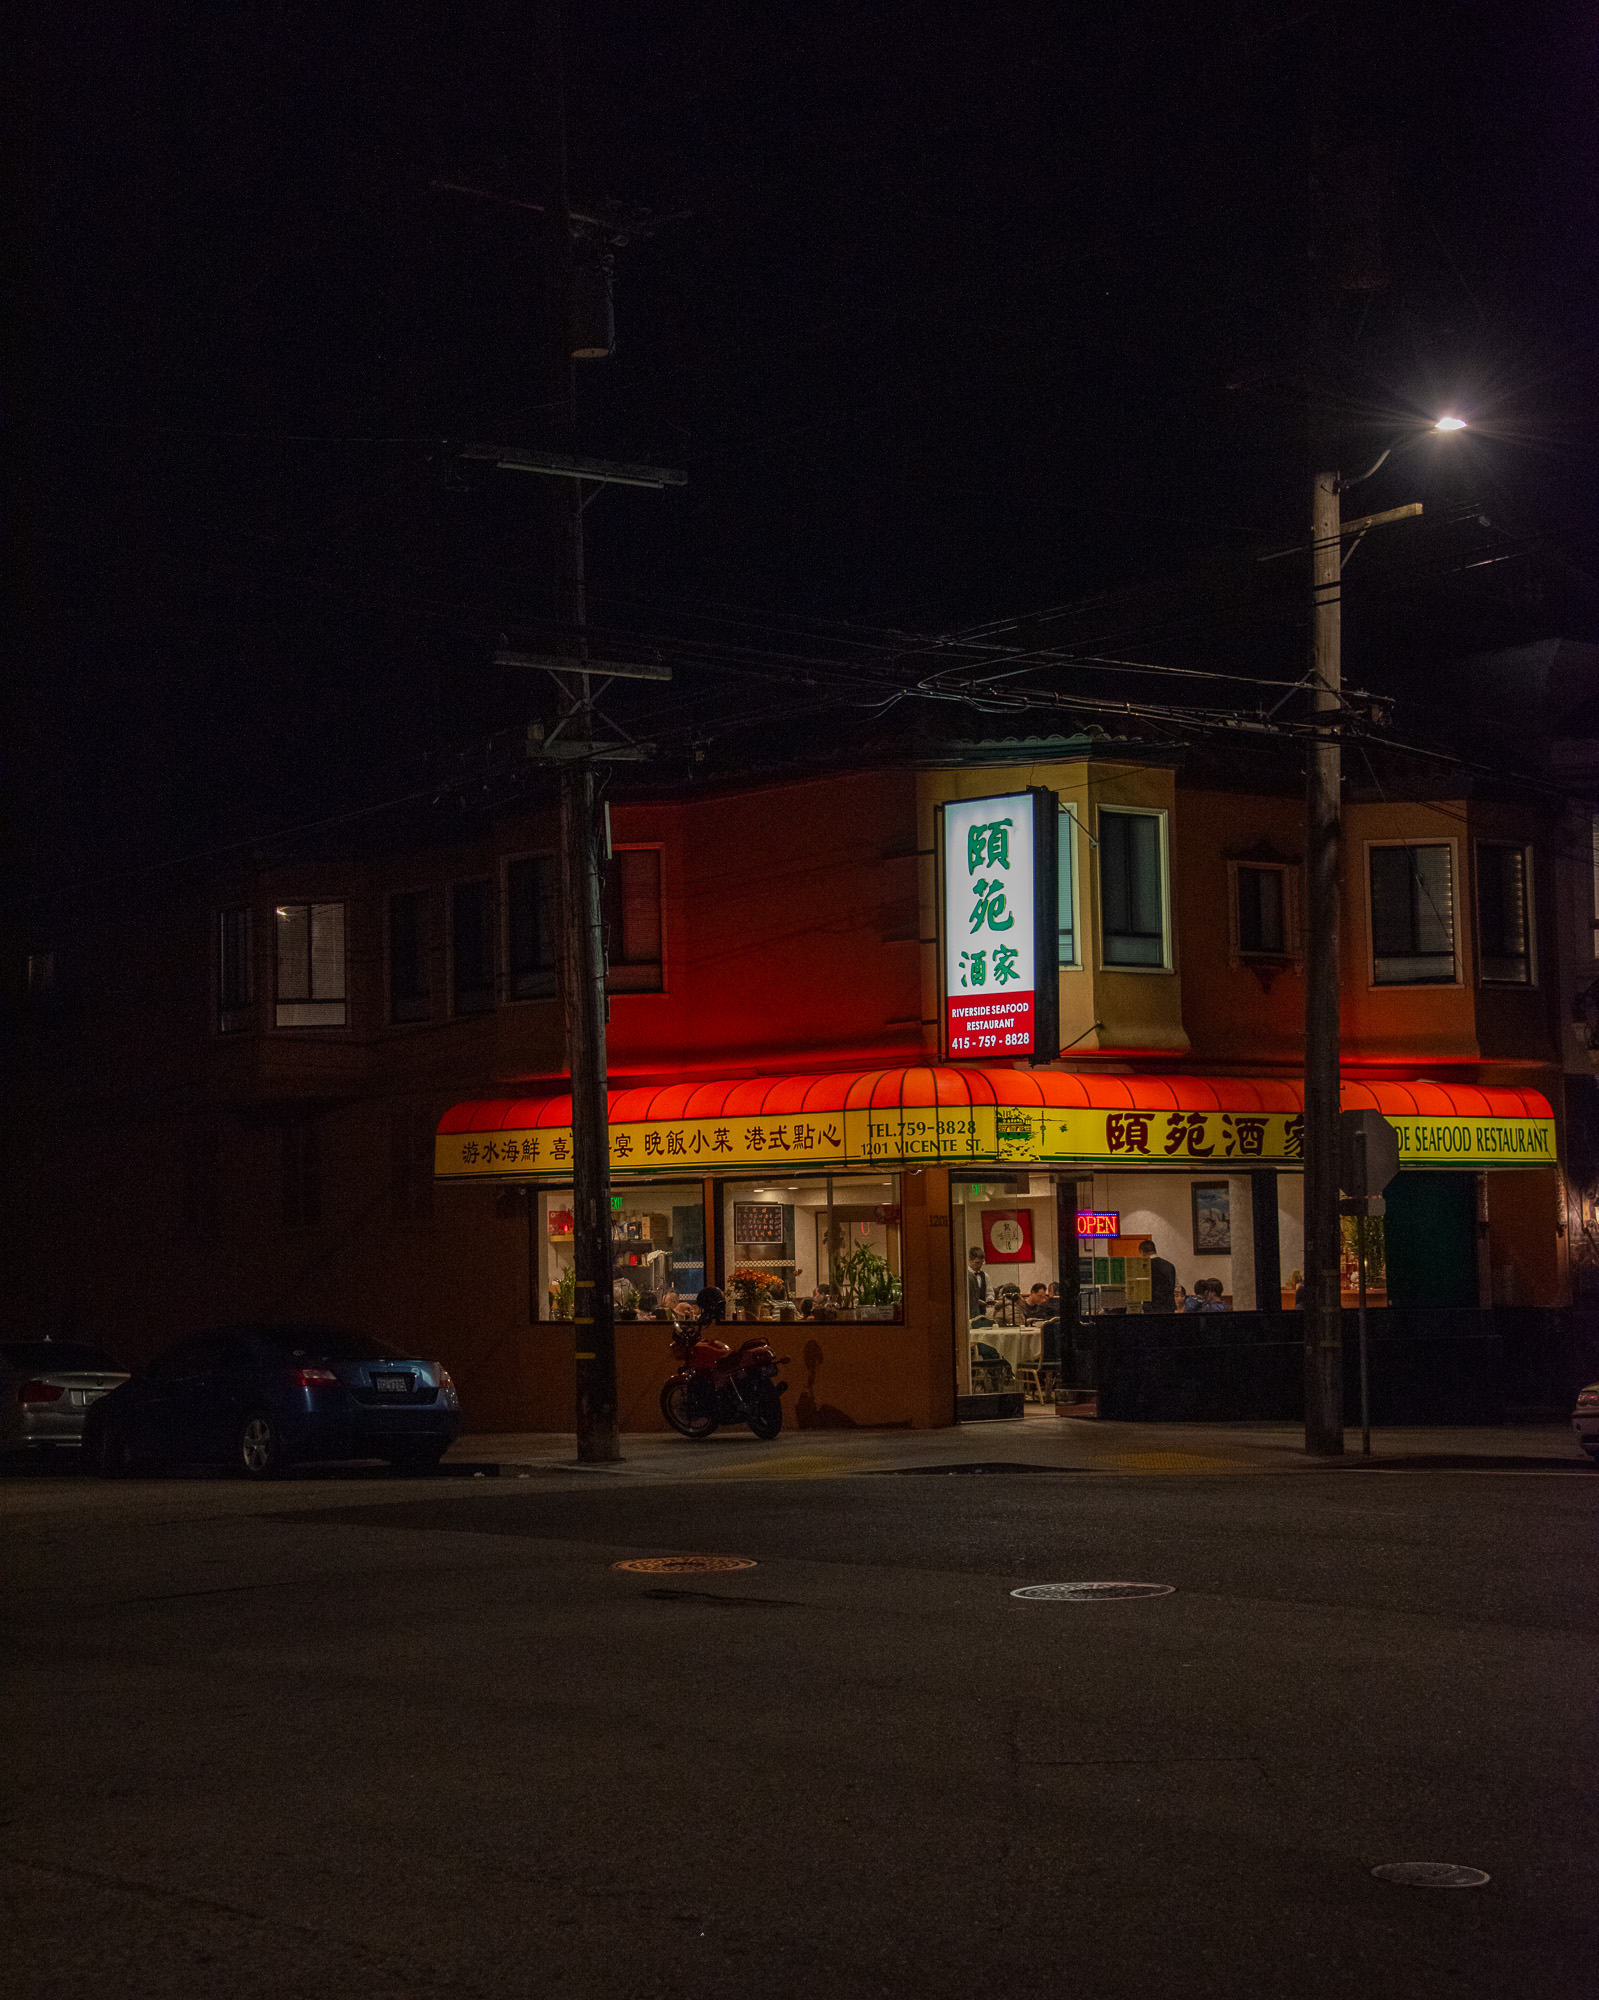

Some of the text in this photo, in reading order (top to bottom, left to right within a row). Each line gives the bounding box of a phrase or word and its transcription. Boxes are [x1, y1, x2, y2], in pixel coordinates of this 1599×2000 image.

[958, 944, 1020, 987] 酒家
[951, 1002, 1029, 1018] RIVERSIDE SEAFOOD
[966, 1018, 1015, 1031] RESTAURANT
[462, 1137, 540, 1164] 游水海鮮
[644, 1127, 733, 1156] 晚飯小菜
[744, 1123, 841, 1151] 港式點心
[861, 1138, 985, 1156] 1201 VICENTE ST.
[1415, 1125, 1471, 1152] SEAFOOD
[1476, 1127, 1549, 1152] RESTAURANT
[1077, 1216, 1117, 1234] OPEN
